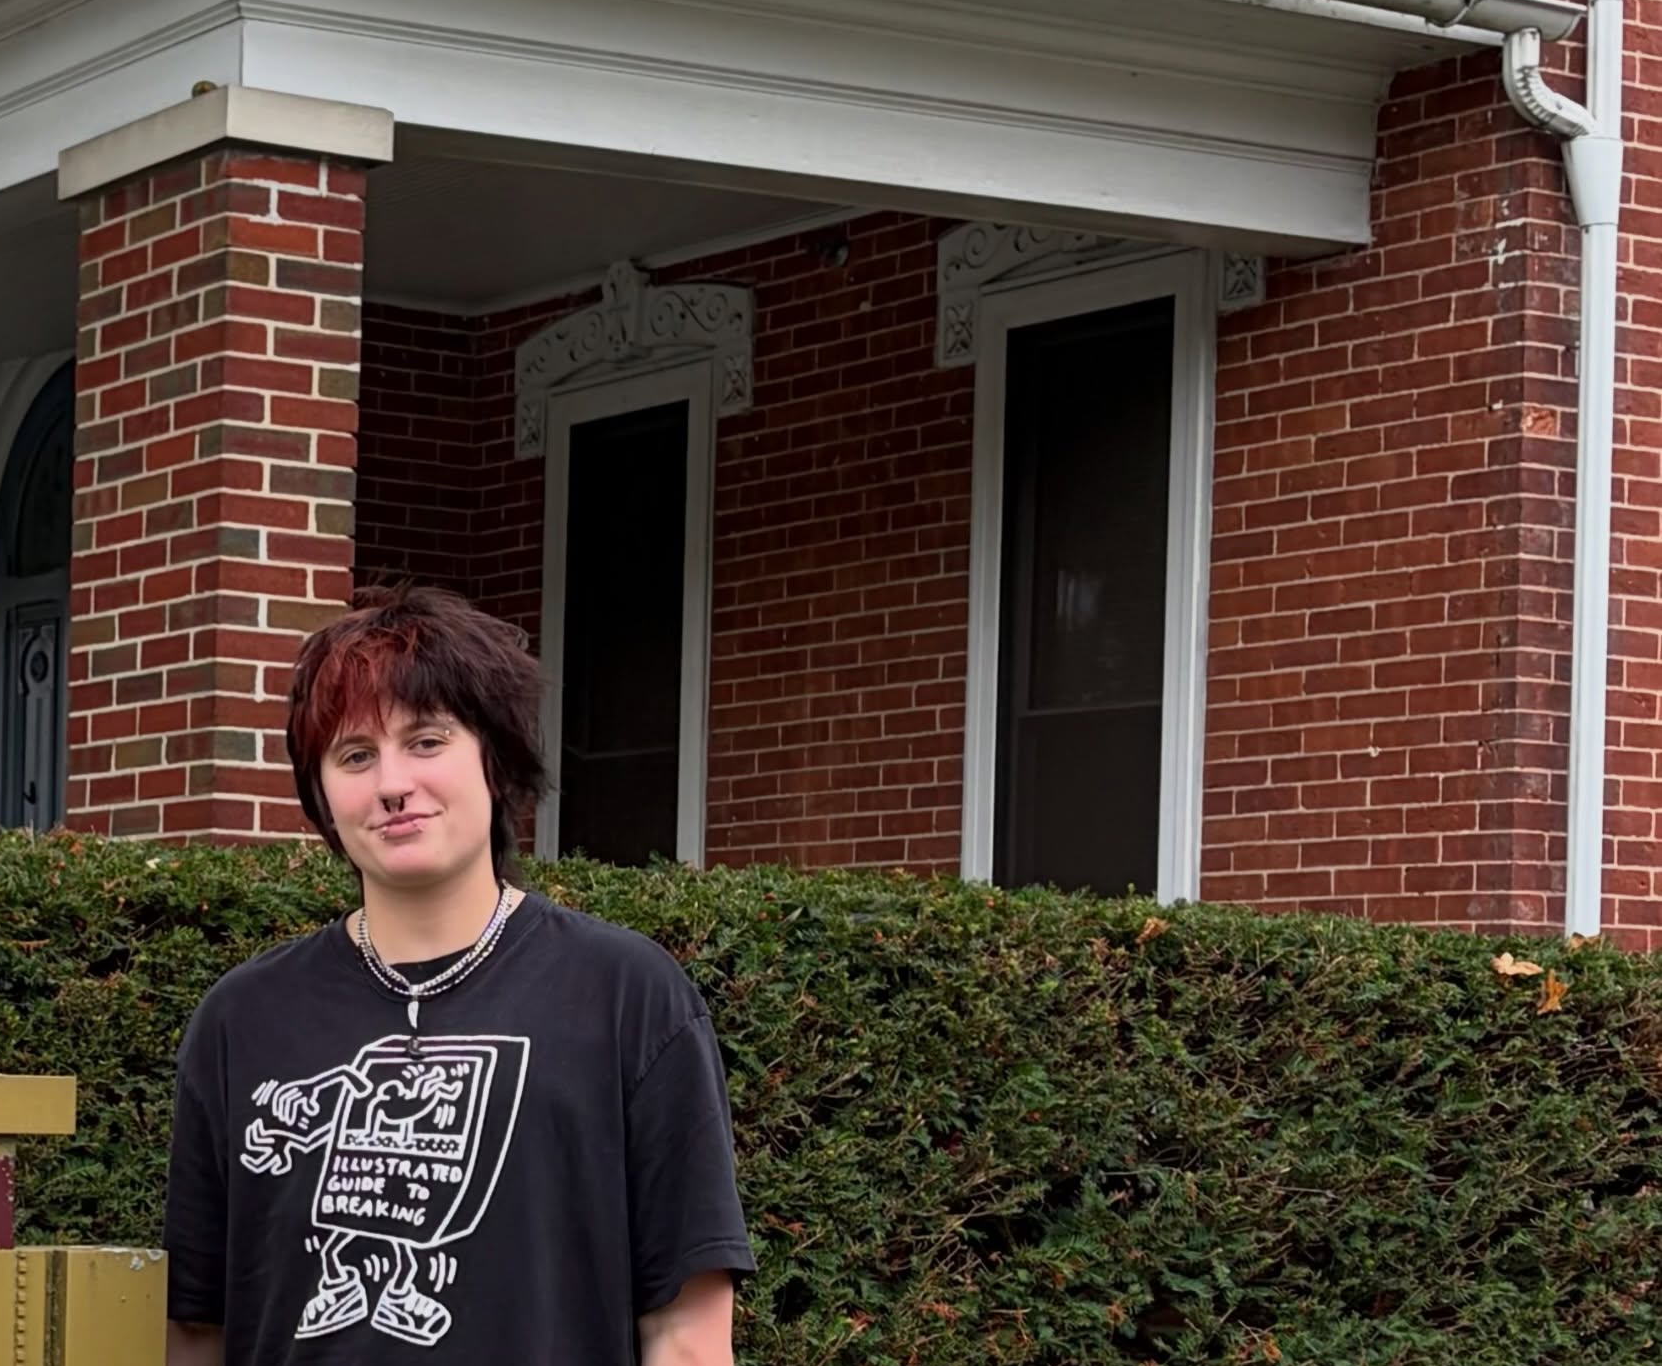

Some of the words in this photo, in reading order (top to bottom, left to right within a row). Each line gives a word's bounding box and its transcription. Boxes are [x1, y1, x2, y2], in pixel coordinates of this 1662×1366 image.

[333, 1155, 463, 1183] ILLUSTRATED
[326, 1175, 385, 1194] GUIDE
[407, 1184, 430, 1200] TO
[322, 1195, 426, 1226] BREAKING
